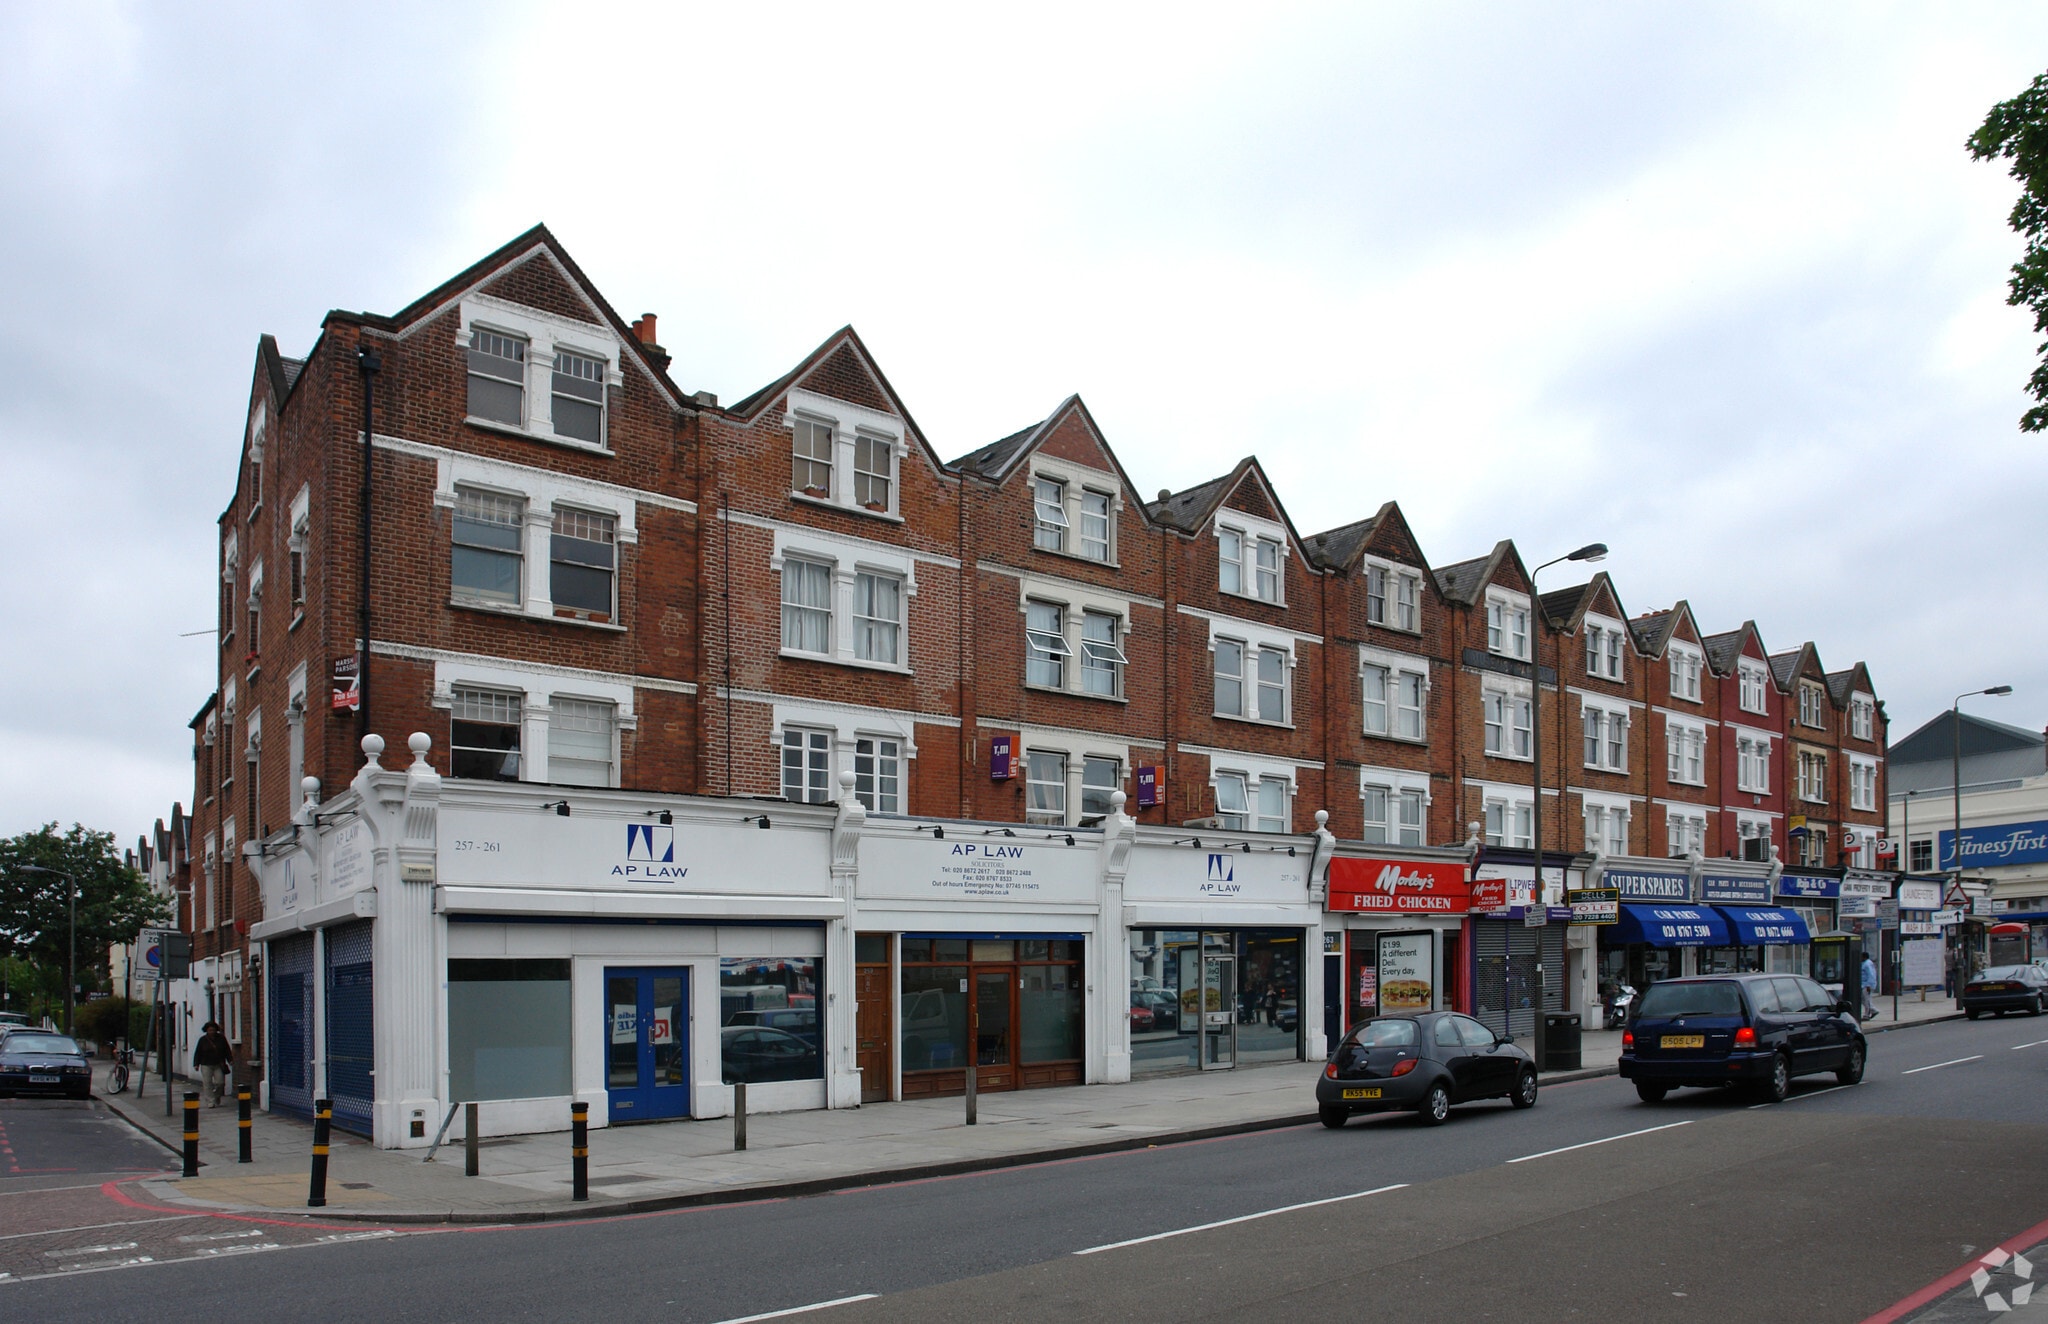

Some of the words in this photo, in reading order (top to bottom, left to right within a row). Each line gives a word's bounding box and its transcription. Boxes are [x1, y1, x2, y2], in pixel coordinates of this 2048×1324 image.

[335, 658, 354, 667] MARSH
[334, 693, 346, 701] FOR
[346, 690, 358, 699] SALE
[455, 840, 473, 852] 257
[483, 841, 501, 853] 261
[952, 844, 976, 855] AP
[984, 845, 1023, 858] LAW
[1942, 836, 2008, 863] Fitness
[1999, 830, 2047, 858] First
[611, 865, 637, 876] AP
[646, 866, 688, 878] LAW
[964, 881, 994, 889] Emergency
[1374, 864, 1435, 896] Morley's
[1817, 879, 1827, 889] Co
[1218, 884, 1240, 892] LAW
[1472, 882, 1503, 897] Morley's
[1610, 875, 1684, 897] SUPERSPARES
[1581, 891, 1607, 900] DELLS
[1353, 895, 1393, 908] FRIED
[1397, 896, 1451, 909] CHICKEN
[1653, 910, 1676, 919] CAR
[1671, 910, 1701, 919] PARTS
[1746, 912, 1764, 921] CAR
[1760, 912, 1785, 921] PARTS
[1662, 925, 1676, 937] 020
[1754, 926, 1766, 937] 020
[1905, 923, 1918, 932] WASH
[1926, 923, 1934, 932] DRY
[1382, 941, 1401, 949] £1.99.
[1388, 949, 1417, 957] different
[1382, 968, 1401, 976] Every
[1402, 967, 1415, 976] day.
